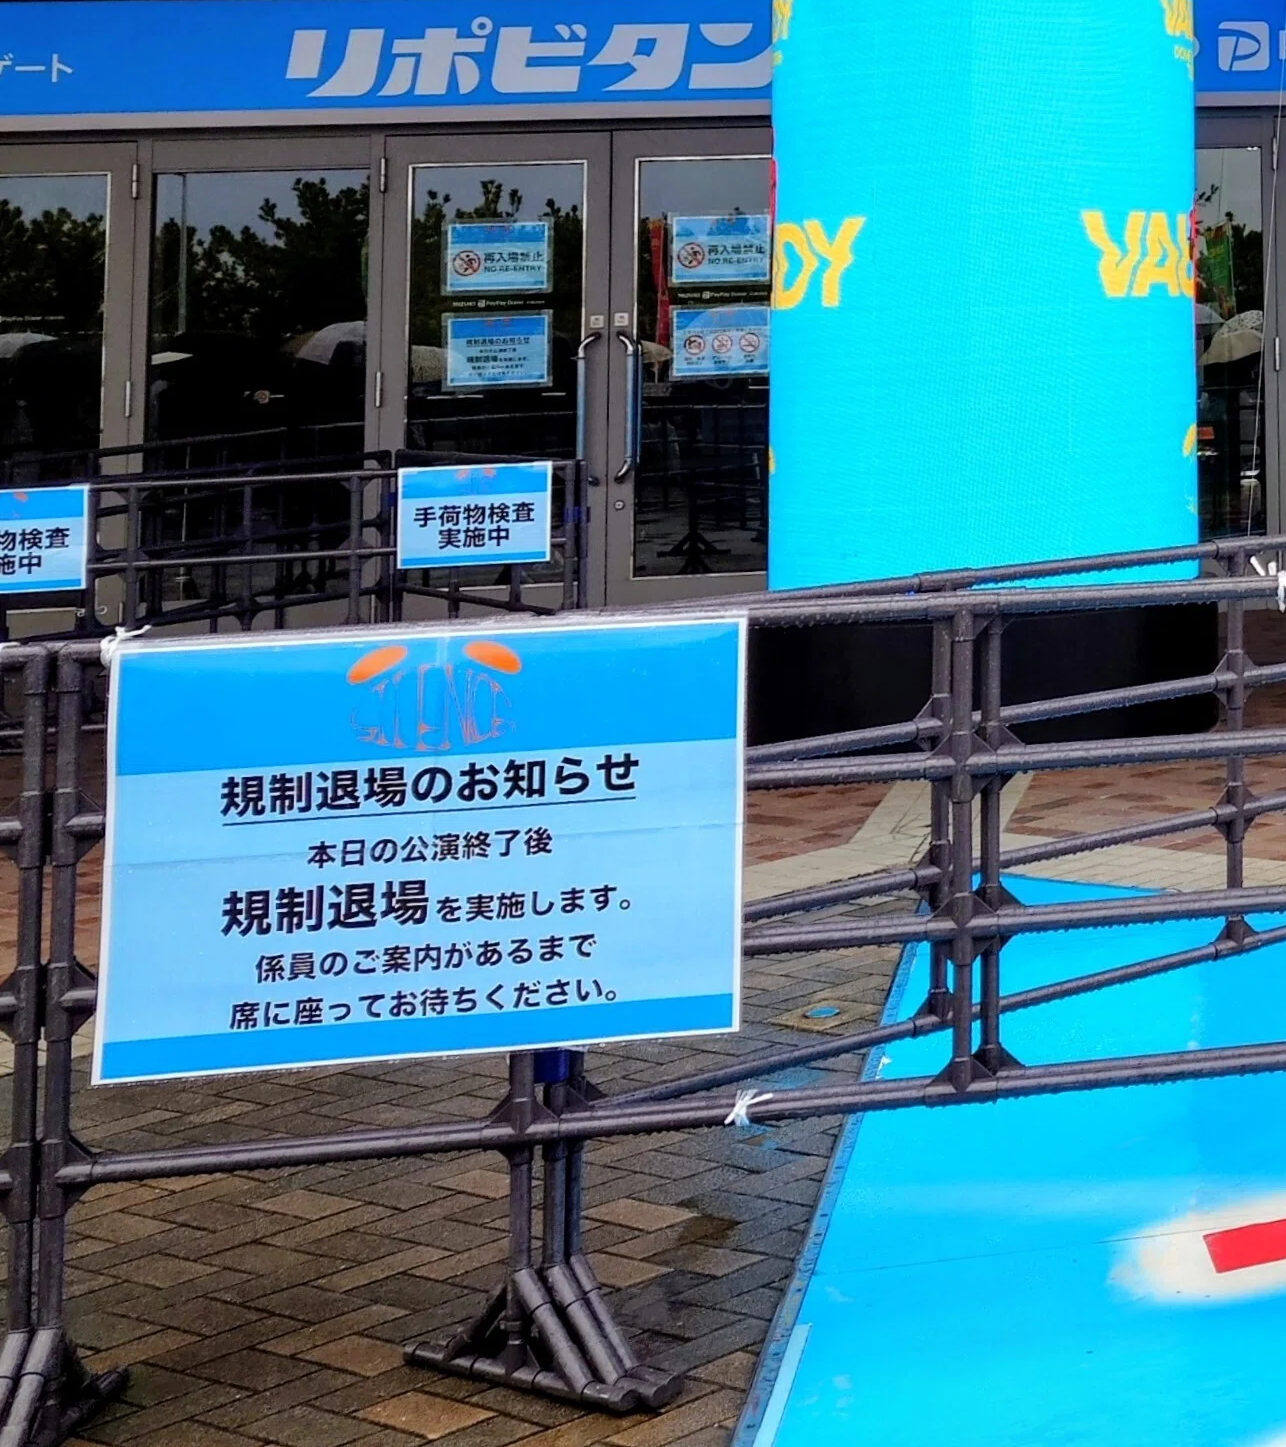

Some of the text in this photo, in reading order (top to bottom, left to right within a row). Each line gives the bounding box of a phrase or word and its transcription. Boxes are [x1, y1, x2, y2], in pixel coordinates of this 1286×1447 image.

[413, 501, 535, 528] 手荷物検査
[438, 525, 510, 549] 実施中
[220, 752, 640, 817] 規制退場のお知らせ
[307, 827, 553, 870] 本日の公演終了後
[220, 881, 633, 938] 規制退場を実施します。
[255, 932, 597, 984] 係員のご案内があるまで
[228, 978, 619, 1031] 席に座ってお待ちください。
